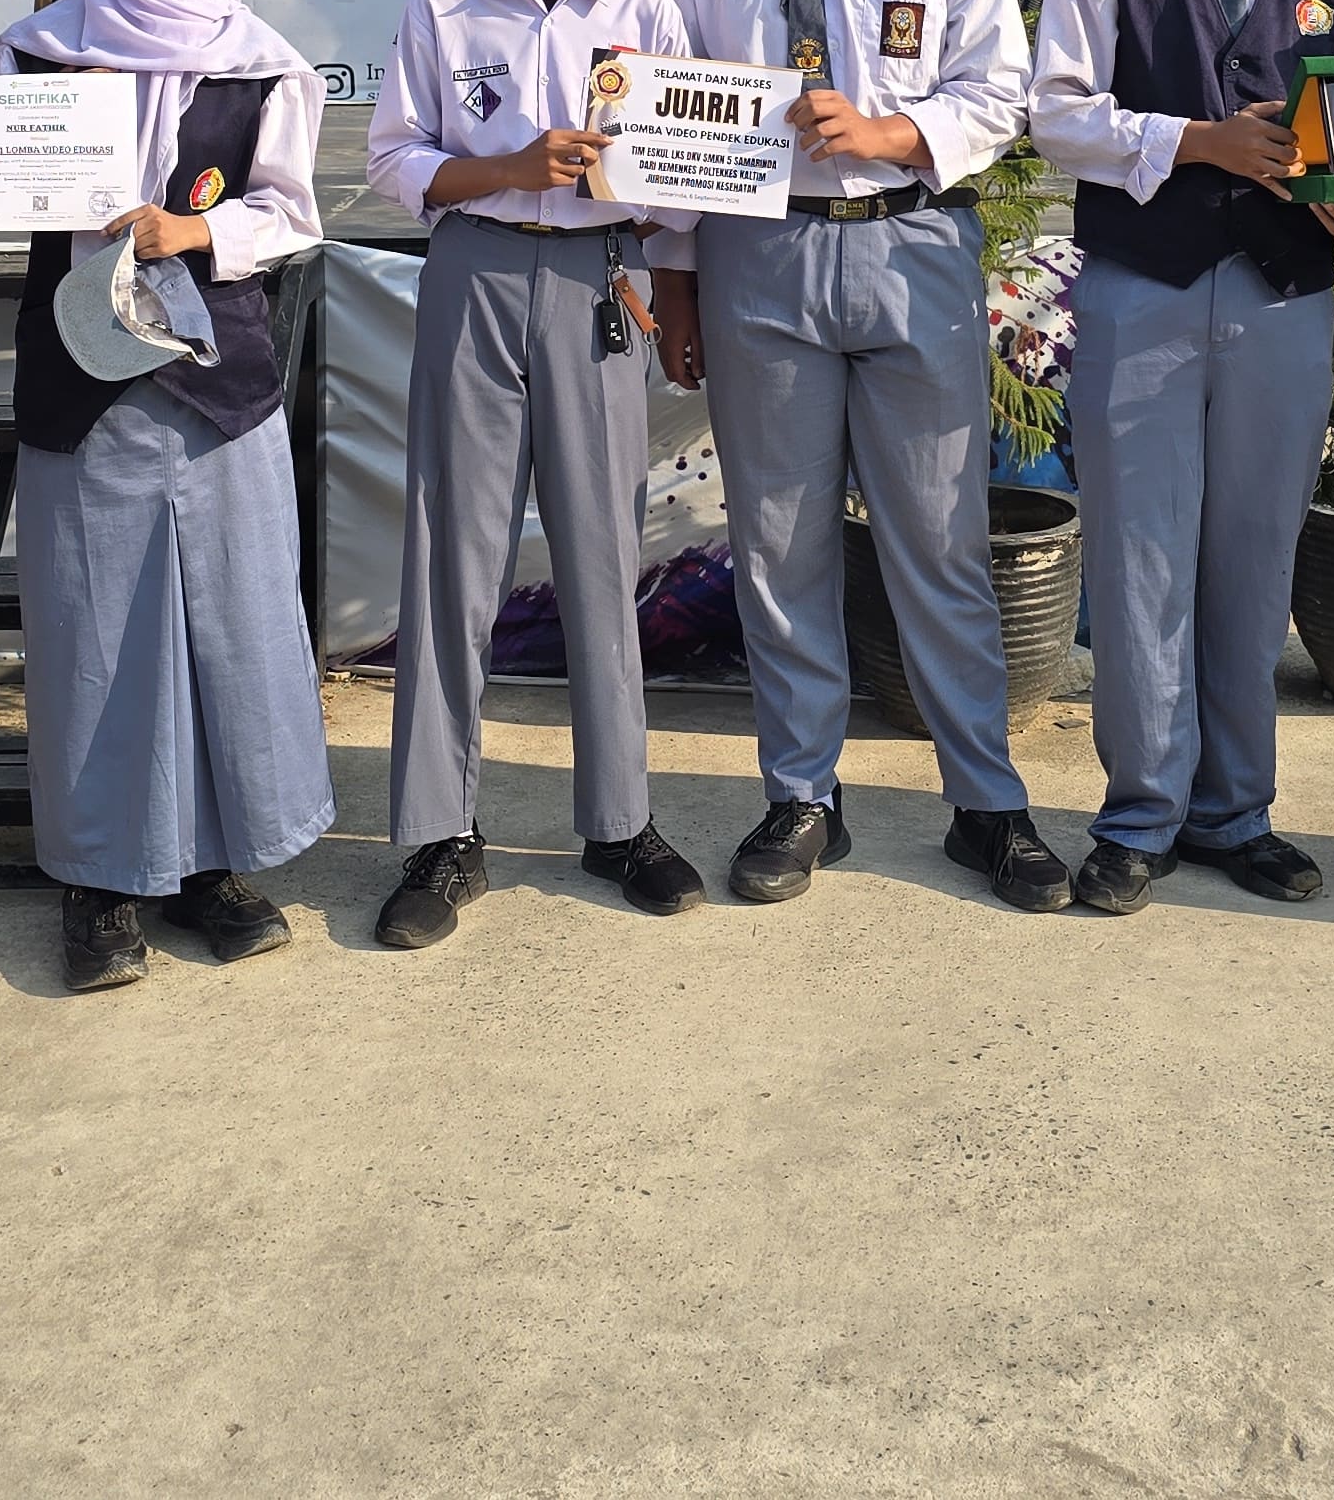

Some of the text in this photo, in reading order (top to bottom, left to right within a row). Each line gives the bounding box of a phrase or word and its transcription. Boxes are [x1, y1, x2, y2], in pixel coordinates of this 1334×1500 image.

[653, 68, 773, 90] SELAMAT DAN SUKSES
[655, 87, 763, 128] JUARA 1
[6, 124, 27, 133] NUR
[624, 122, 790, 149] LOMBA VIDEO PENDEK EDUKASI
[6, 146, 40, 155] LOMBA
[42, 145, 72, 155] VIDEO
[73, 145, 114, 155] EDUKASI
[631, 145, 646, 157] TIM
[647, 147, 670, 159] ESKUL
[702, 151, 726, 164] SMKN
[726, 154, 733, 165] 5
[733, 155, 777, 170] SAMARINDA
[639, 159, 767, 182] DARI KEMENKES POLTEKKES KALTIM
[645, 172, 758, 194] JURUSAN PROMOSI KESEHATAN
